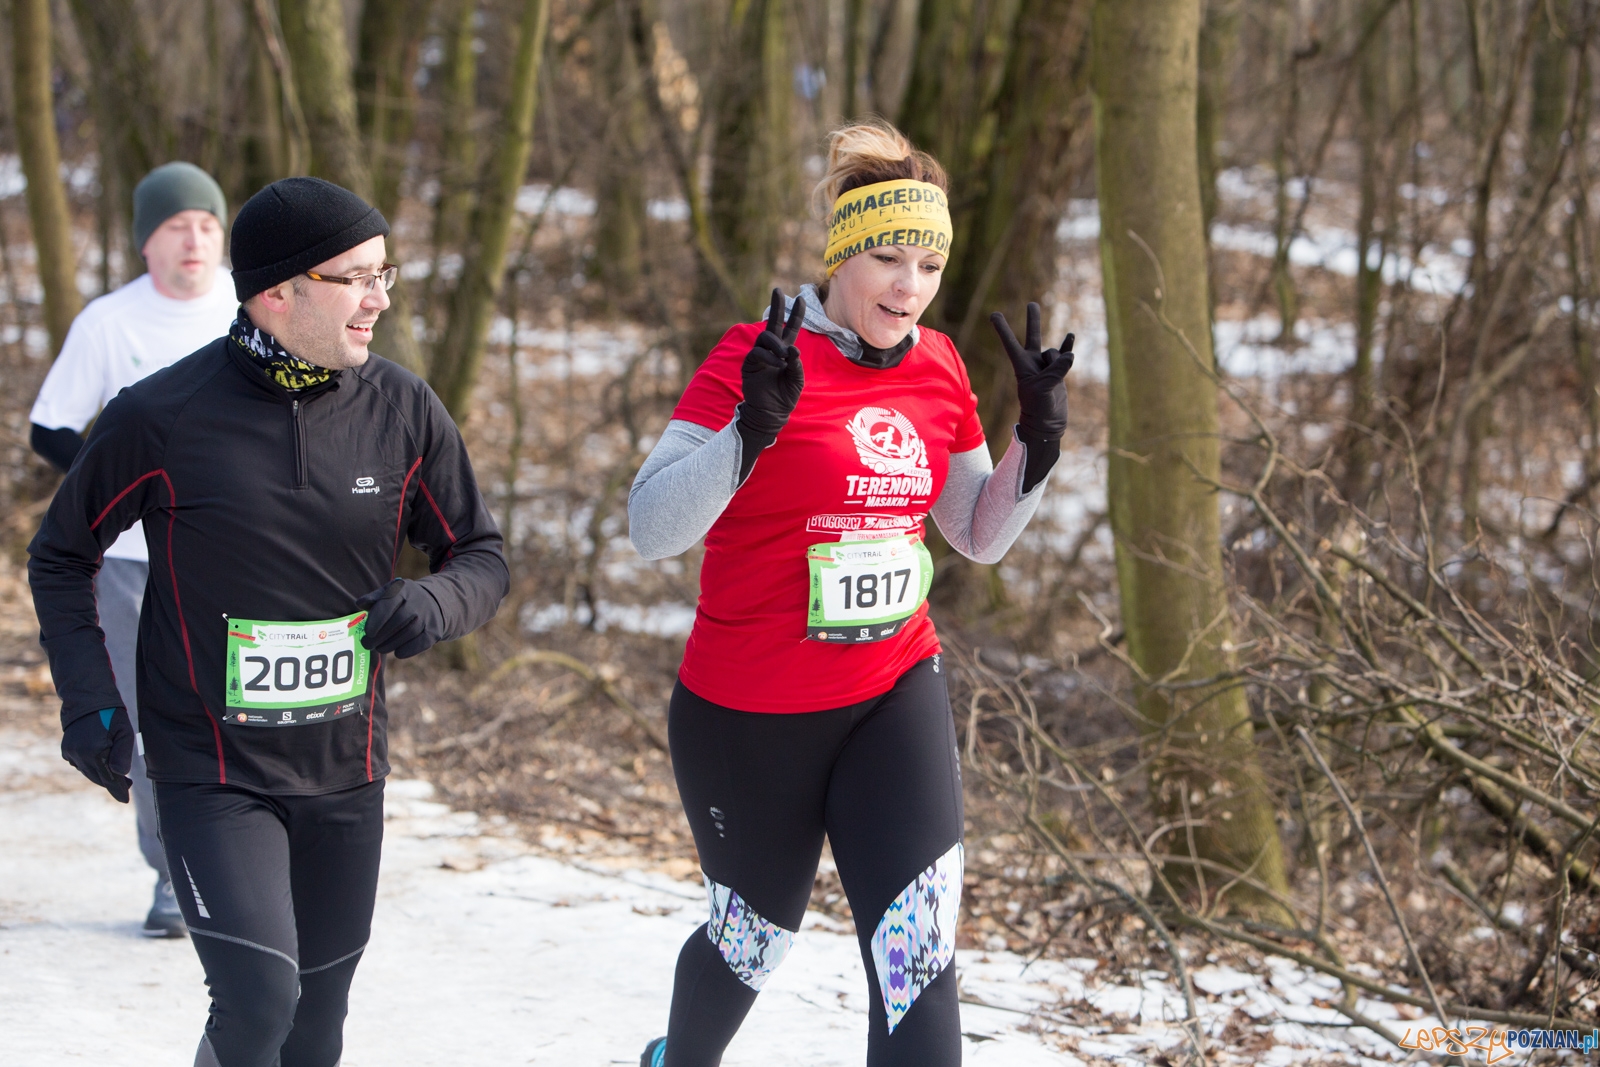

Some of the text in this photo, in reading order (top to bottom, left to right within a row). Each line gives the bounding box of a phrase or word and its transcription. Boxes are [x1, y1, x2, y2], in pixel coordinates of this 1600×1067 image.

[831, 188, 946, 229] UNMAGEDDO
[832, 204, 946, 237] KRUT FINISH
[846, 475, 933, 496] TERENOWA
[864, 496, 910, 507] MASAKRA
[811, 516, 861, 530] BYDGOSZCZ
[839, 568, 911, 609] 1817
[245, 649, 354, 691] 2080
[357, 652, 366, 685] Poznań
